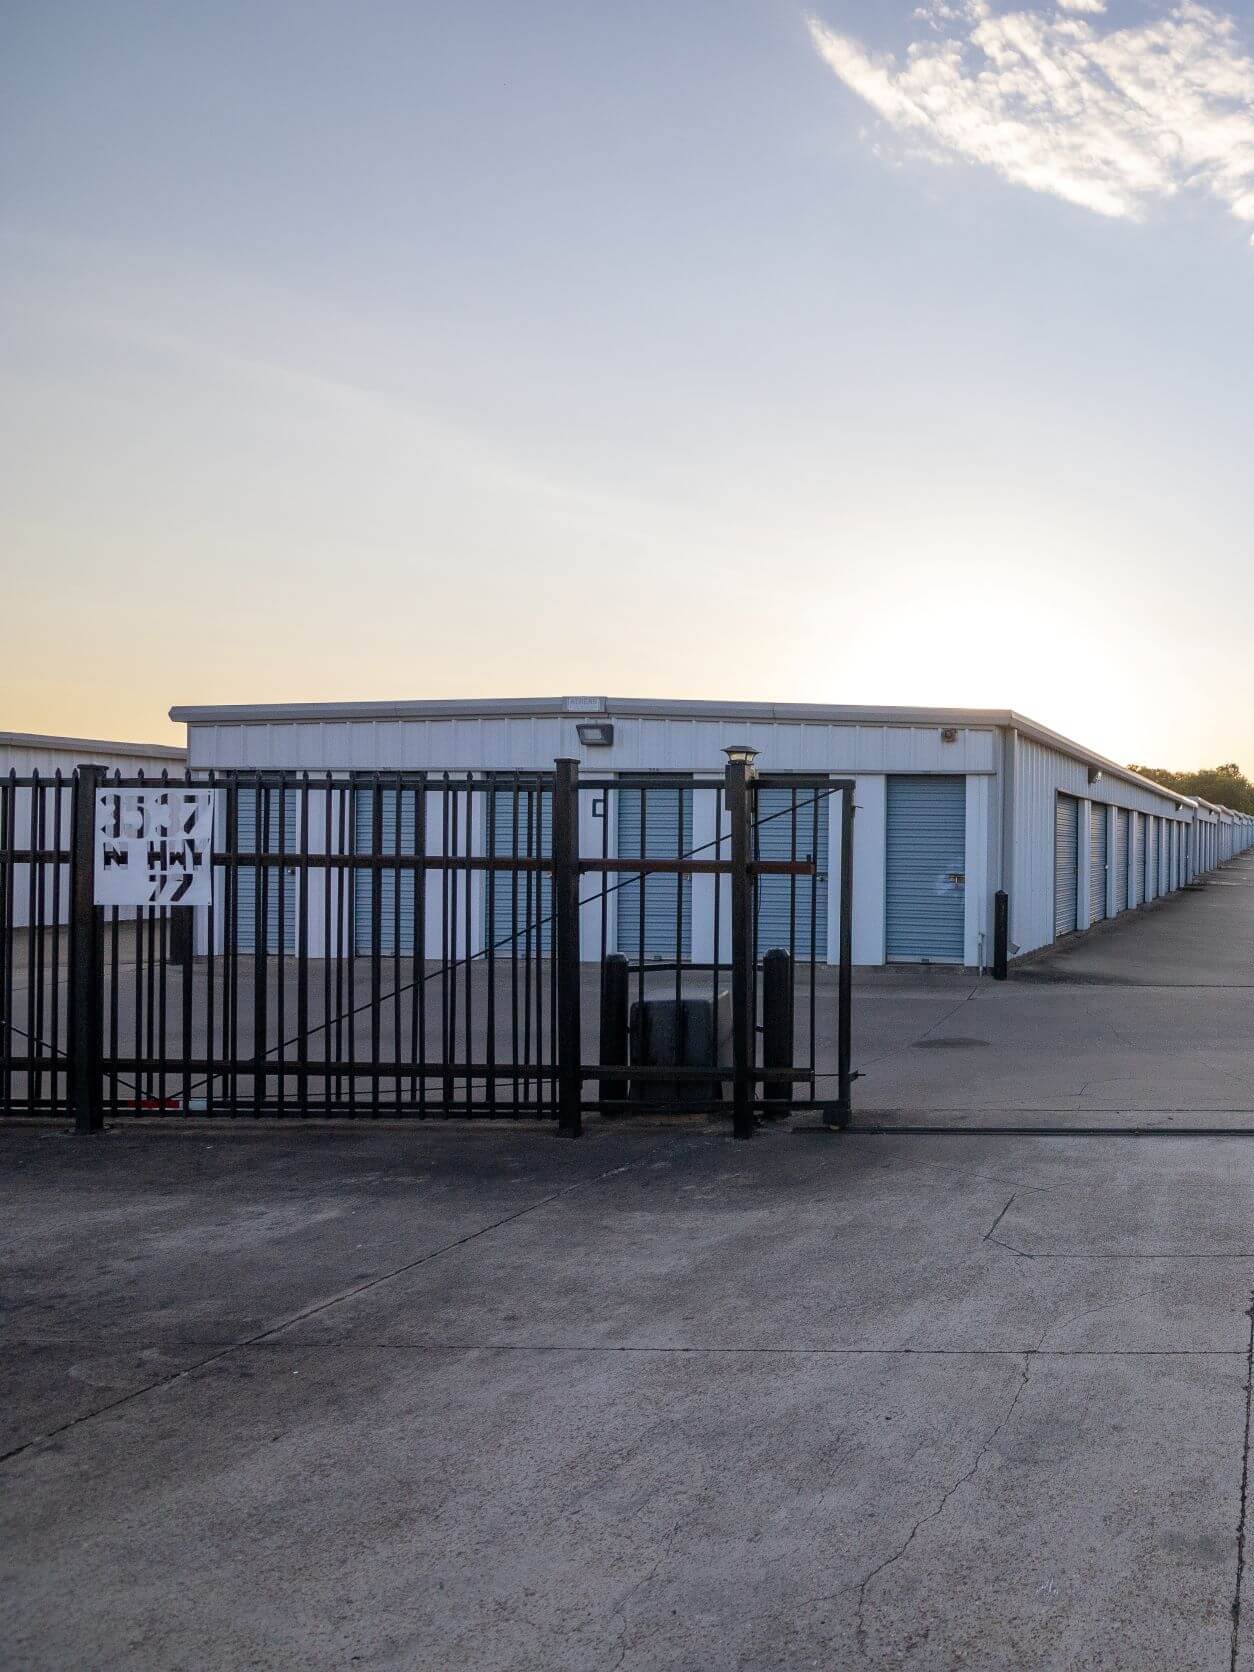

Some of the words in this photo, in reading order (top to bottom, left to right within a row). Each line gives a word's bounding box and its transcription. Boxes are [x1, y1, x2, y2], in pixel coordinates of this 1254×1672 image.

[103, 841, 129, 871] N
[147, 839, 210, 871] HWY
[148, 874, 194, 902] 77
